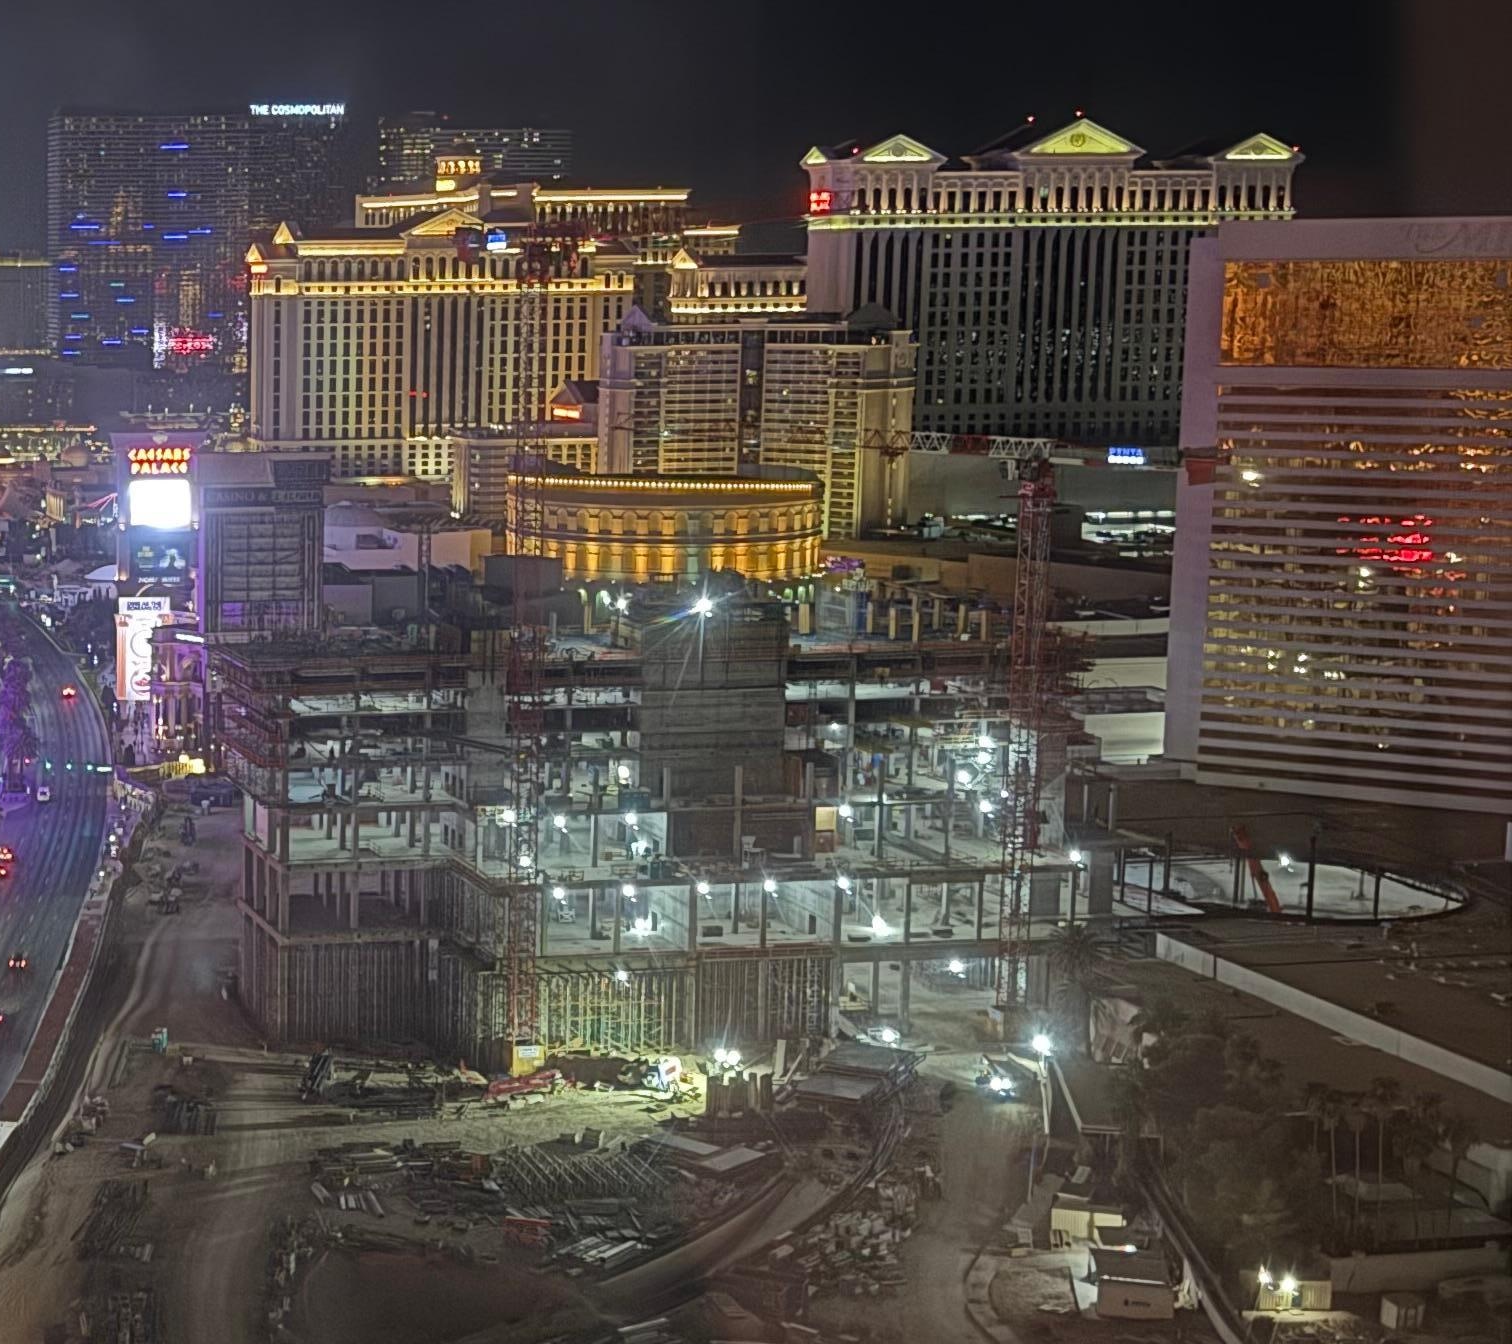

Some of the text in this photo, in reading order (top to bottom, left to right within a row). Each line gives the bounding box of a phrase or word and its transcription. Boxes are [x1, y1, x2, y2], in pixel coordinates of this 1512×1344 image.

[250, 104, 345, 115] THE COSMOPOLITAN
[128, 447, 191, 461] CAESARS
[131, 462, 188, 474] PALACE
